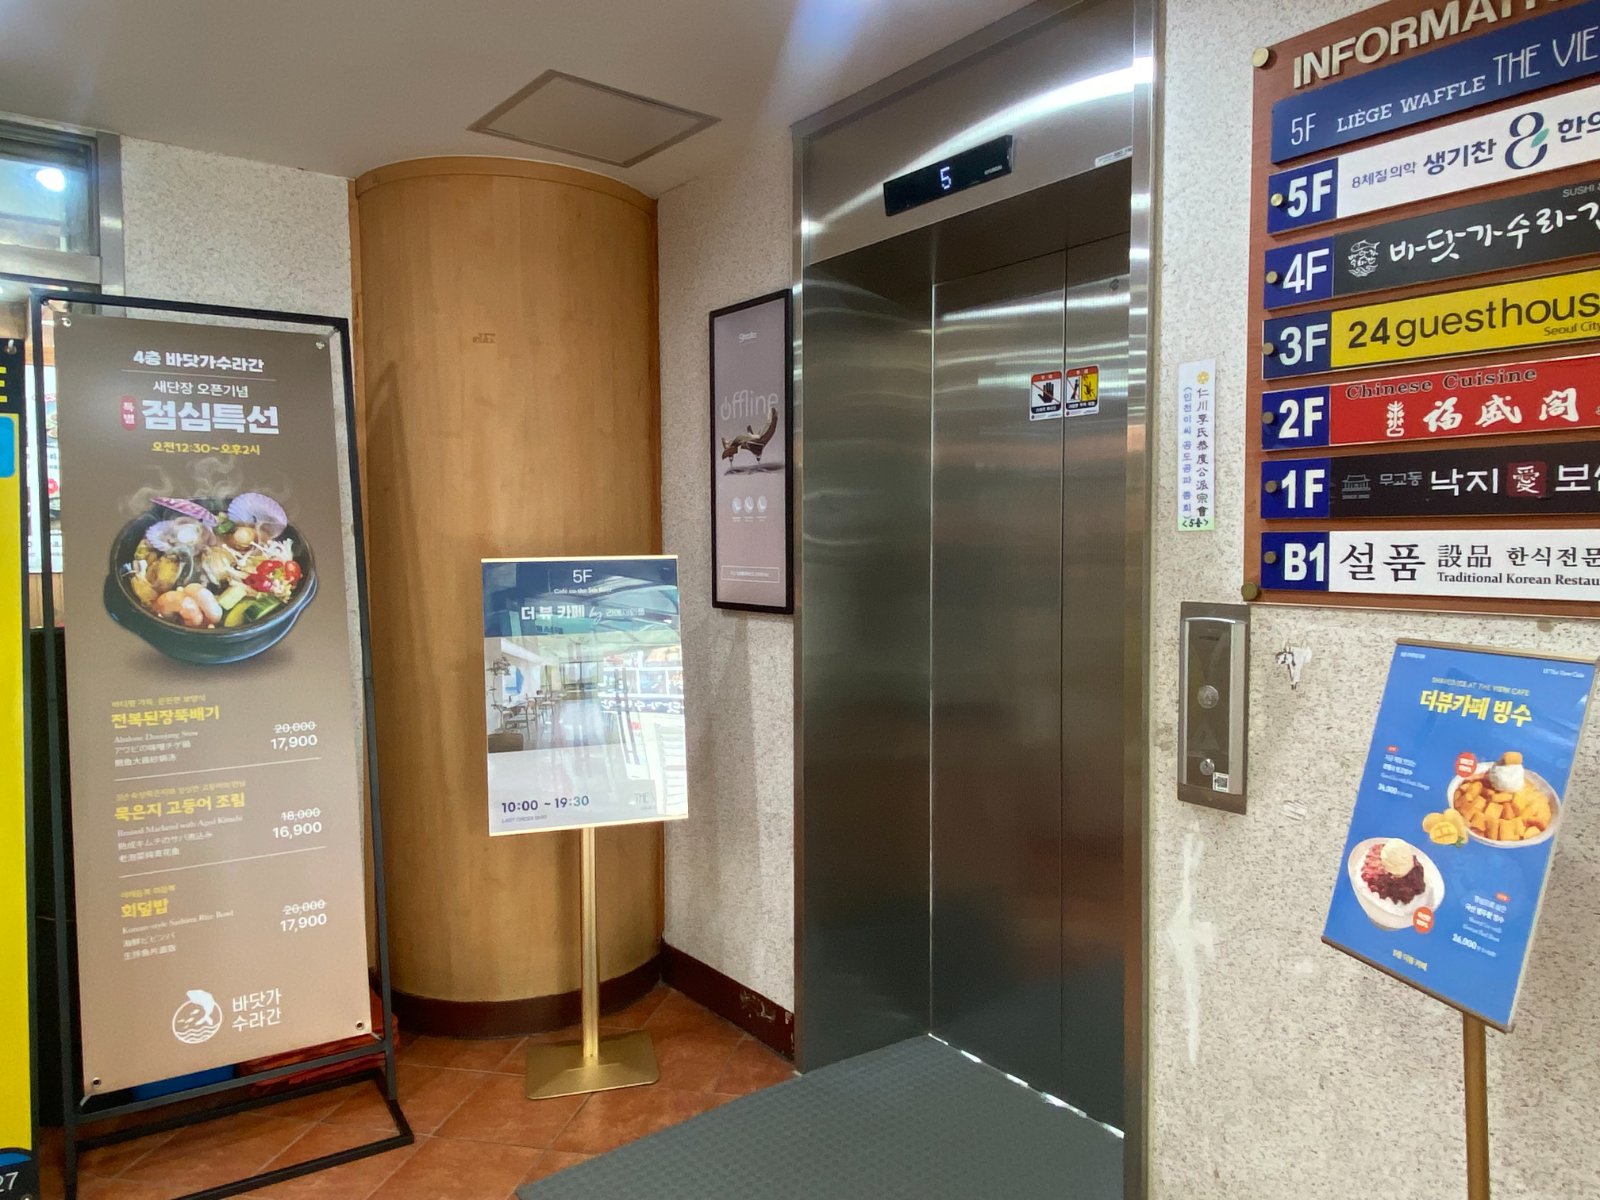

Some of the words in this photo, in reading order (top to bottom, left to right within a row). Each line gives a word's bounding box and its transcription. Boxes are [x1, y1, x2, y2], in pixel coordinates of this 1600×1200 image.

[1293, 0, 1535, 88] INFORMA
[1291, 112, 1317, 146] 5F
[1336, 103, 1393, 133] LIÈGE
[1401, 76, 1486, 114] WAFFLE
[1493, 43, 1541, 86] THE
[1423, 137, 1498, 175] 생기찬
[940, 166, 952, 190] 5
[1287, 168, 1334, 218] 5F
[1562, 184, 1595, 198] SUSHI
[1282, 248, 1330, 294] 4F
[1543, 323, 1578, 337] Seoul
[1279, 322, 1329, 366] 3F
[133, 350, 161, 366] 4층
[165, 352, 265, 373] 바닷가수라간
[152, 380, 193, 394] 새단장
[197, 383, 249, 398] 오픈기념
[1346, 379, 1433, 400] Chinese
[1443, 367, 1537, 390] Cuisine
[142, 399, 279, 434] 점심특선
[1278, 396, 1325, 439] 2F
[1281, 468, 1325, 509] 1F
[1379, 470, 1423, 487] 무교동
[1431, 467, 1499, 496] 낙지
[1512, 464, 1540, 494] 愛
[1555, 463, 1600, 492] 보
[1284, 542, 1325, 582] B1
[1438, 544, 1492, 568] 設品
[572, 569, 593, 584] 5F
[1437, 571, 1502, 584] Traditional
[1506, 573, 1551, 585] Korean
[111, 705, 220, 729] 전복된장뚝배기
[1420, 690, 1491, 720] 더뷰카페
[1493, 700, 1533, 727] 빙수
[270, 734, 318, 751] 17,900
[114, 802, 162, 821] 묵은지
[166, 796, 212, 816] 고등어
[216, 792, 246, 809] 조림
[280, 807, 322, 822] 18,000
[501, 800, 539, 814] 10:00
[554, 795, 589, 809] 19:30
[272, 821, 322, 840] 16,900
[121, 897, 169, 918] 회덮밥
[280, 913, 328, 932] 17,900
[232, 987, 282, 1012] 바닷가
[232, 1007, 282, 1032] 수라간
